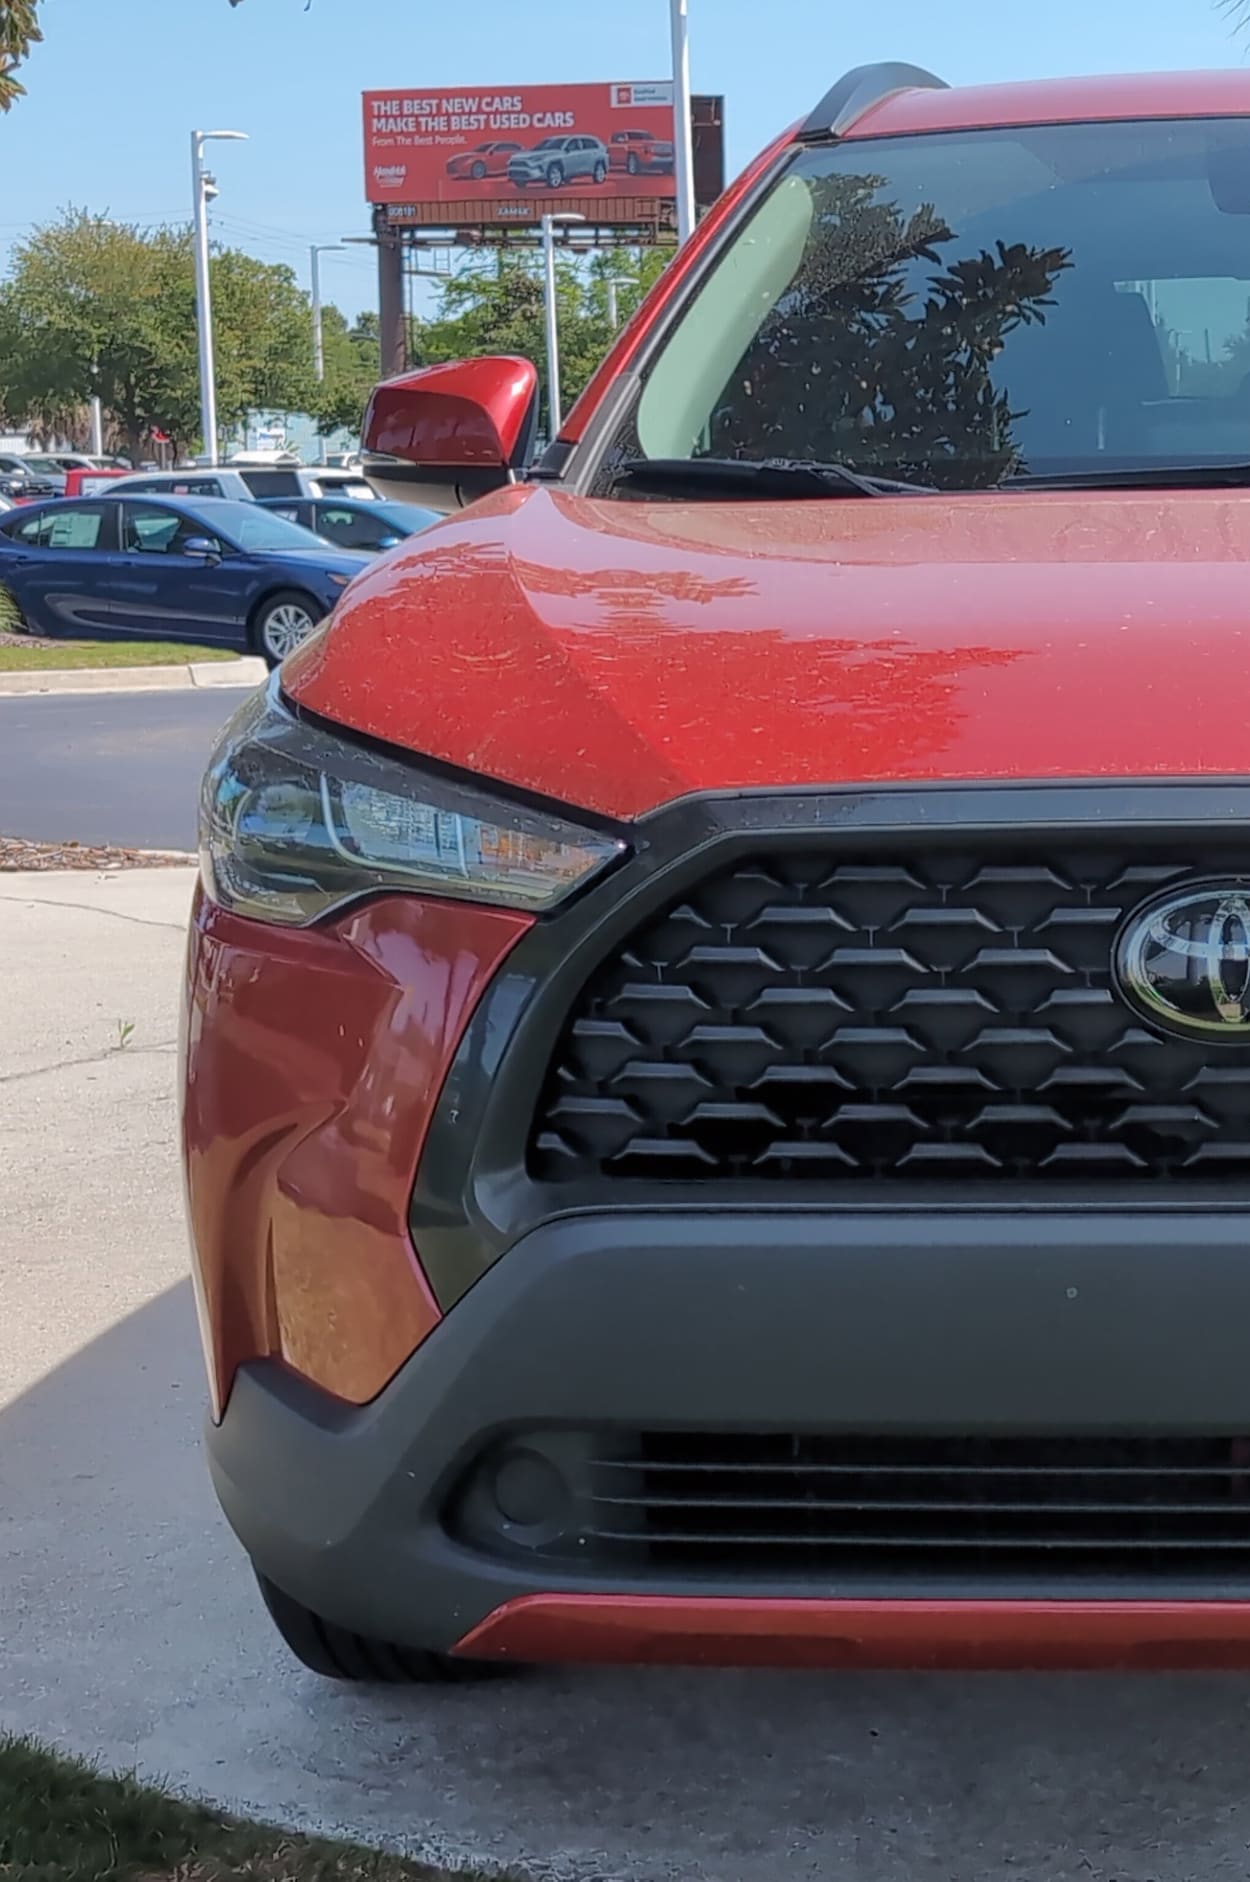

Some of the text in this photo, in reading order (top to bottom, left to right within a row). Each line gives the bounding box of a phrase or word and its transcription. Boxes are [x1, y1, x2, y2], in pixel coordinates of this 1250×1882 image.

[372, 96, 522, 115] THE BEST NEW CARS
[372, 111, 574, 133] MAKE THE BEST USED CARS
[372, 136, 394, 146] From
[396, 135, 412, 145] The
[414, 135, 433, 145] Best
